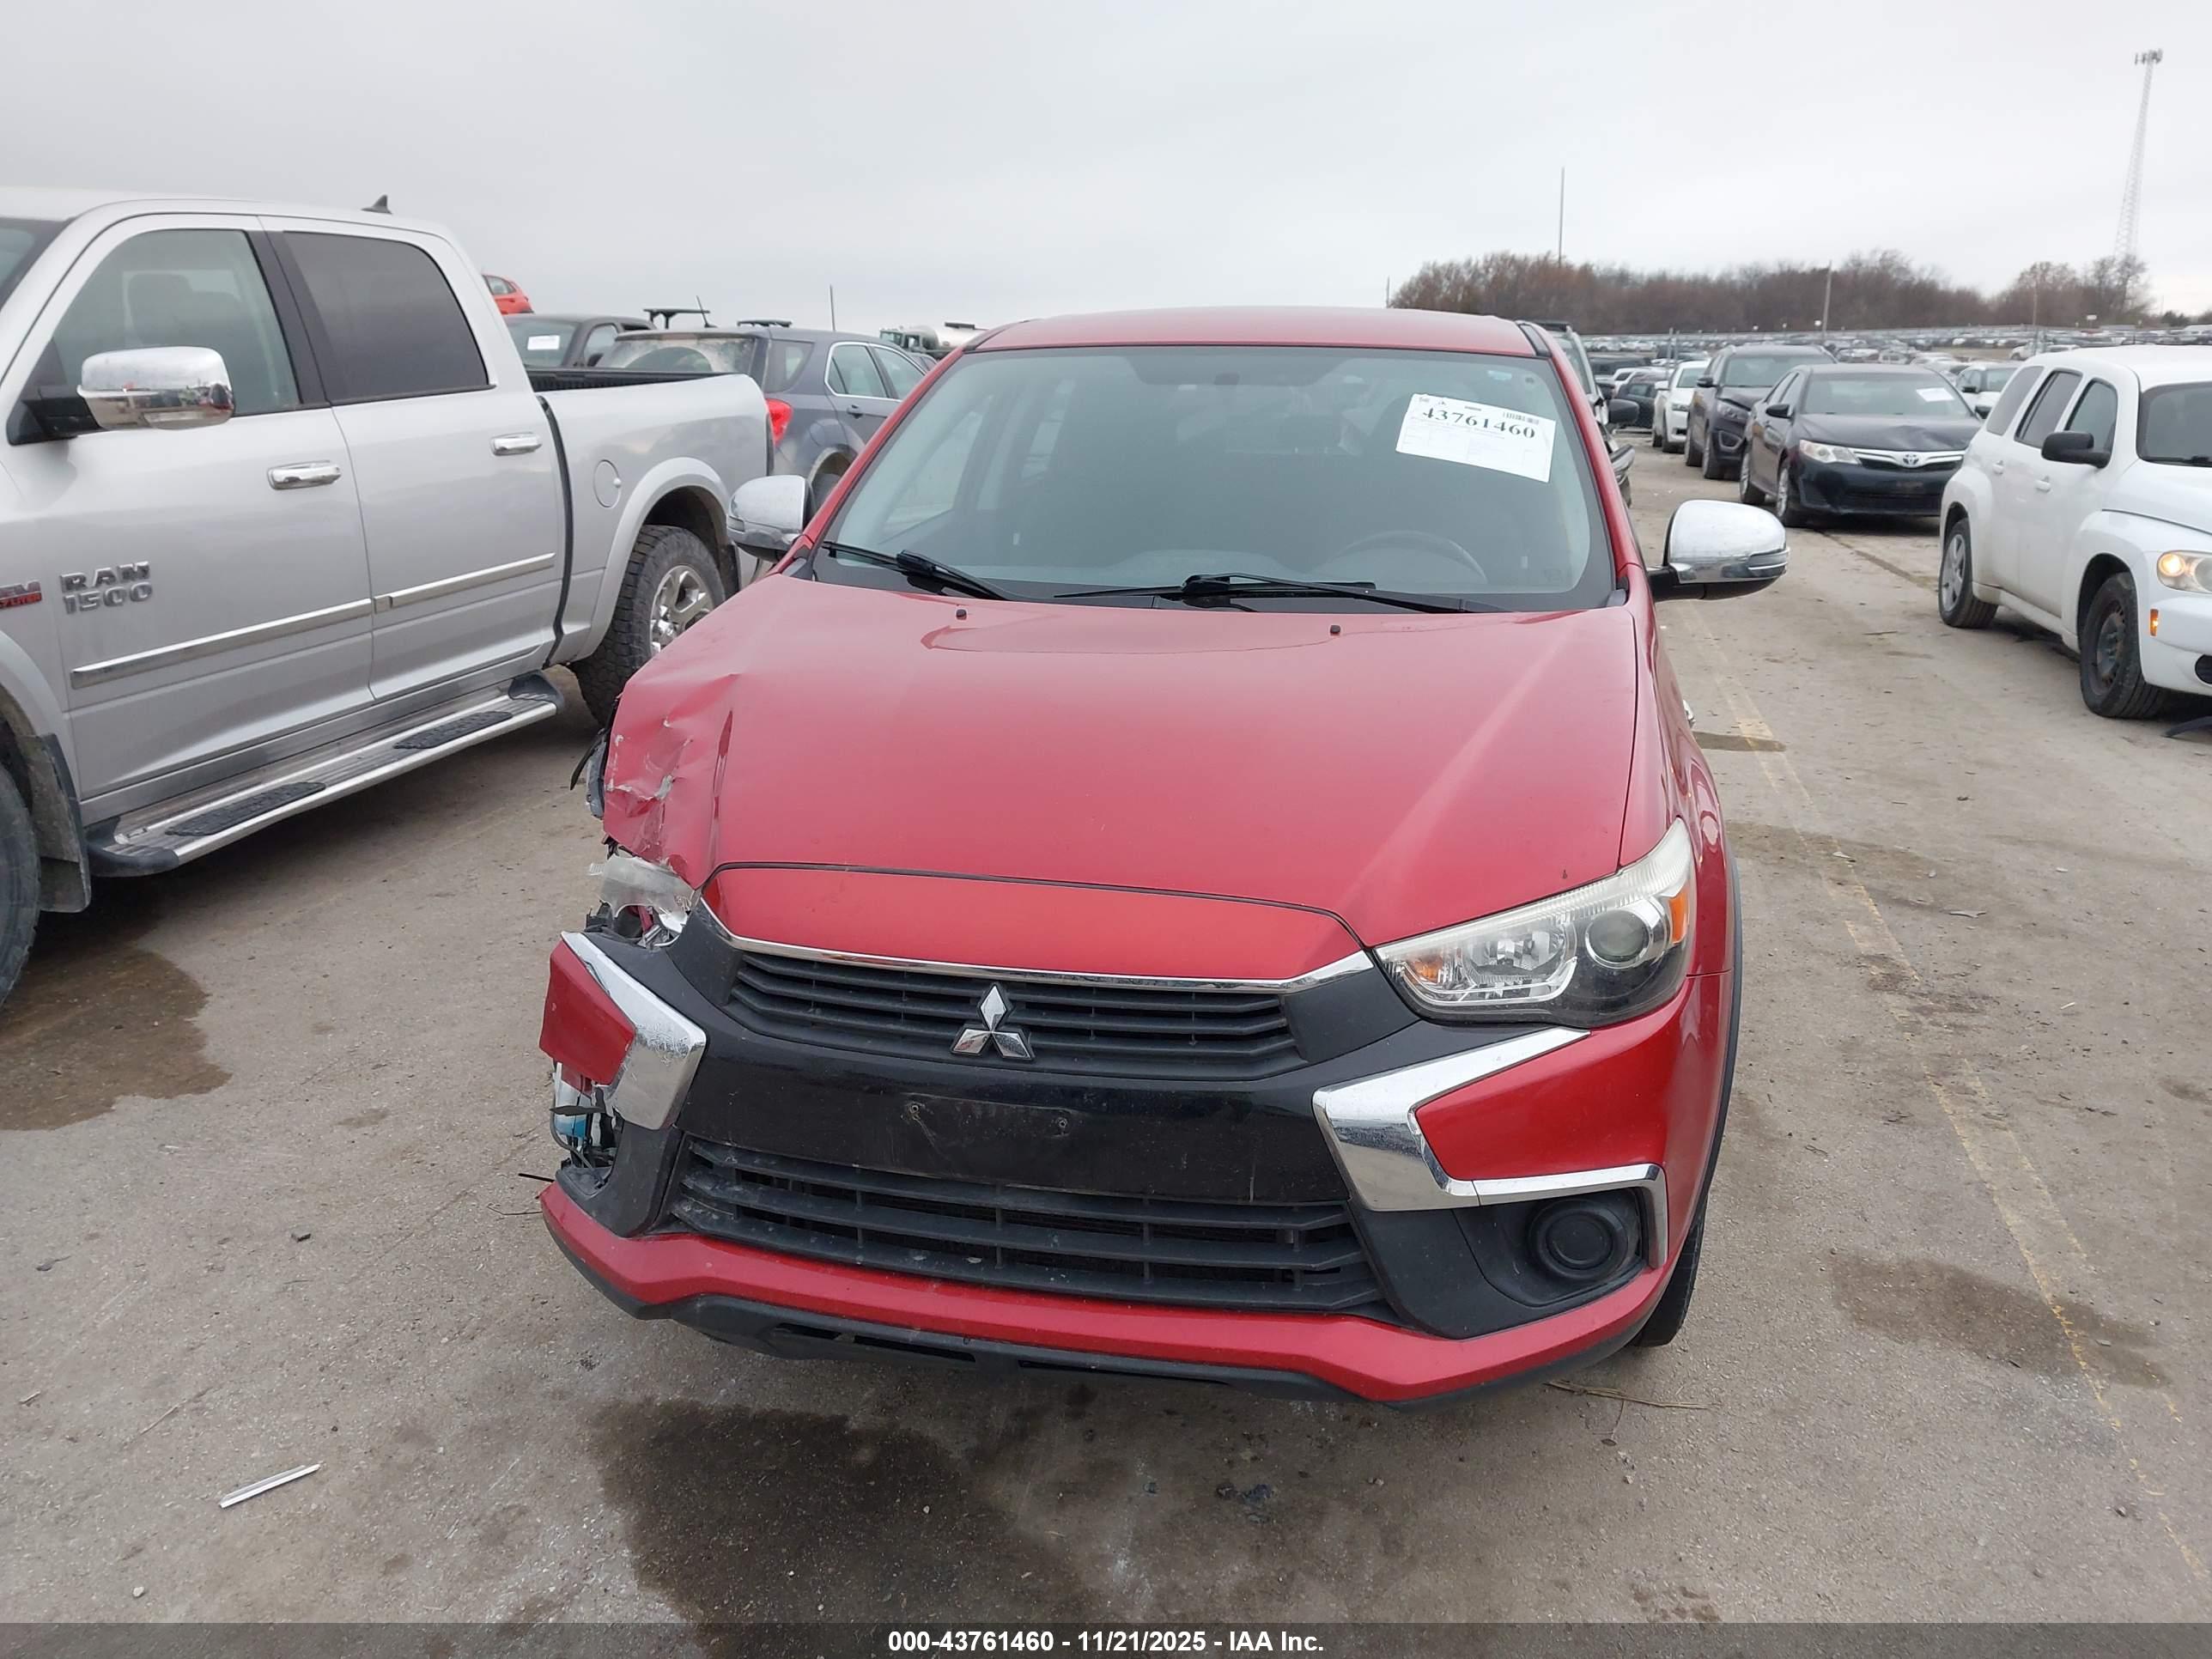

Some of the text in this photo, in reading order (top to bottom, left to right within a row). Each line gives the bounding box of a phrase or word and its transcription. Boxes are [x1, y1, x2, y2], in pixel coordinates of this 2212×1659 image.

[1422, 407, 1535, 439] 43761460
[59, 560, 151, 593] RAM
[63, 581, 153, 615] 1500
